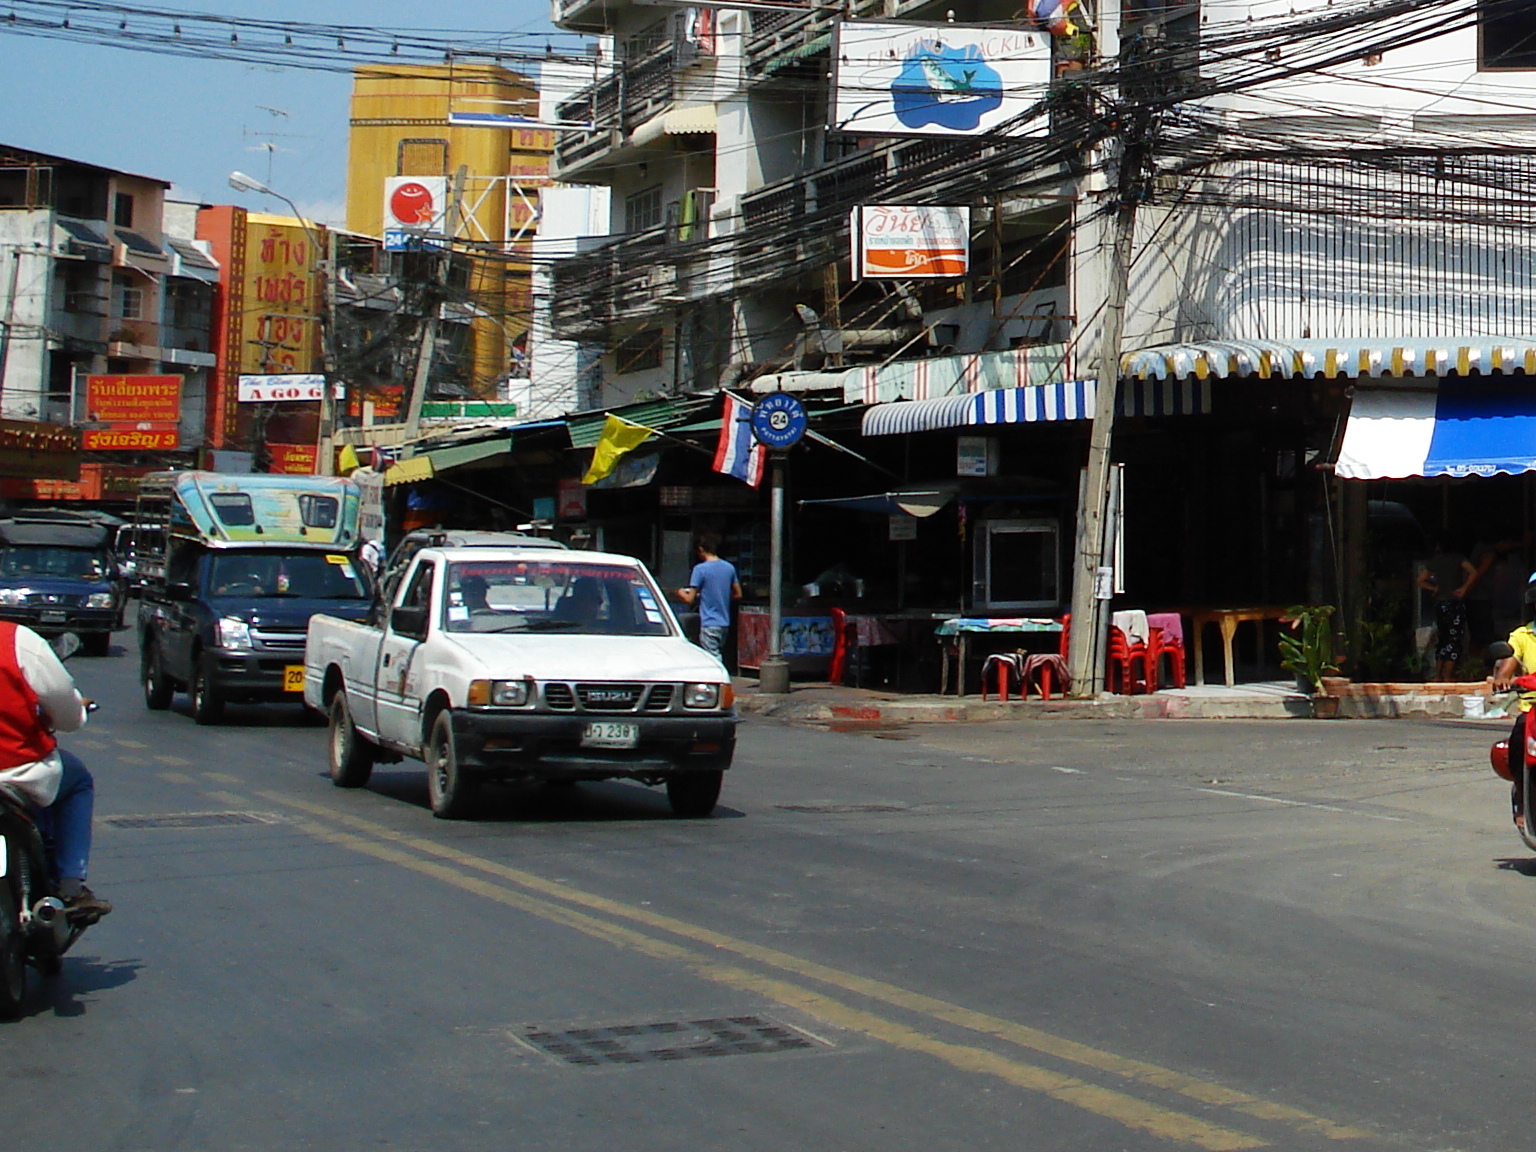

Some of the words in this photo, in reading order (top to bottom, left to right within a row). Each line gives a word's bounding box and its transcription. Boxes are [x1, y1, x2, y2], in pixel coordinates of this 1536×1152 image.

[965, 34, 1036, 63] TACKLE
[387, 234, 401, 246] 24
[251, 389, 263, 399] A
[271, 388, 300, 399] GO
[772, 414, 787, 426] 24
[587, 691, 632, 701] ISUZU
